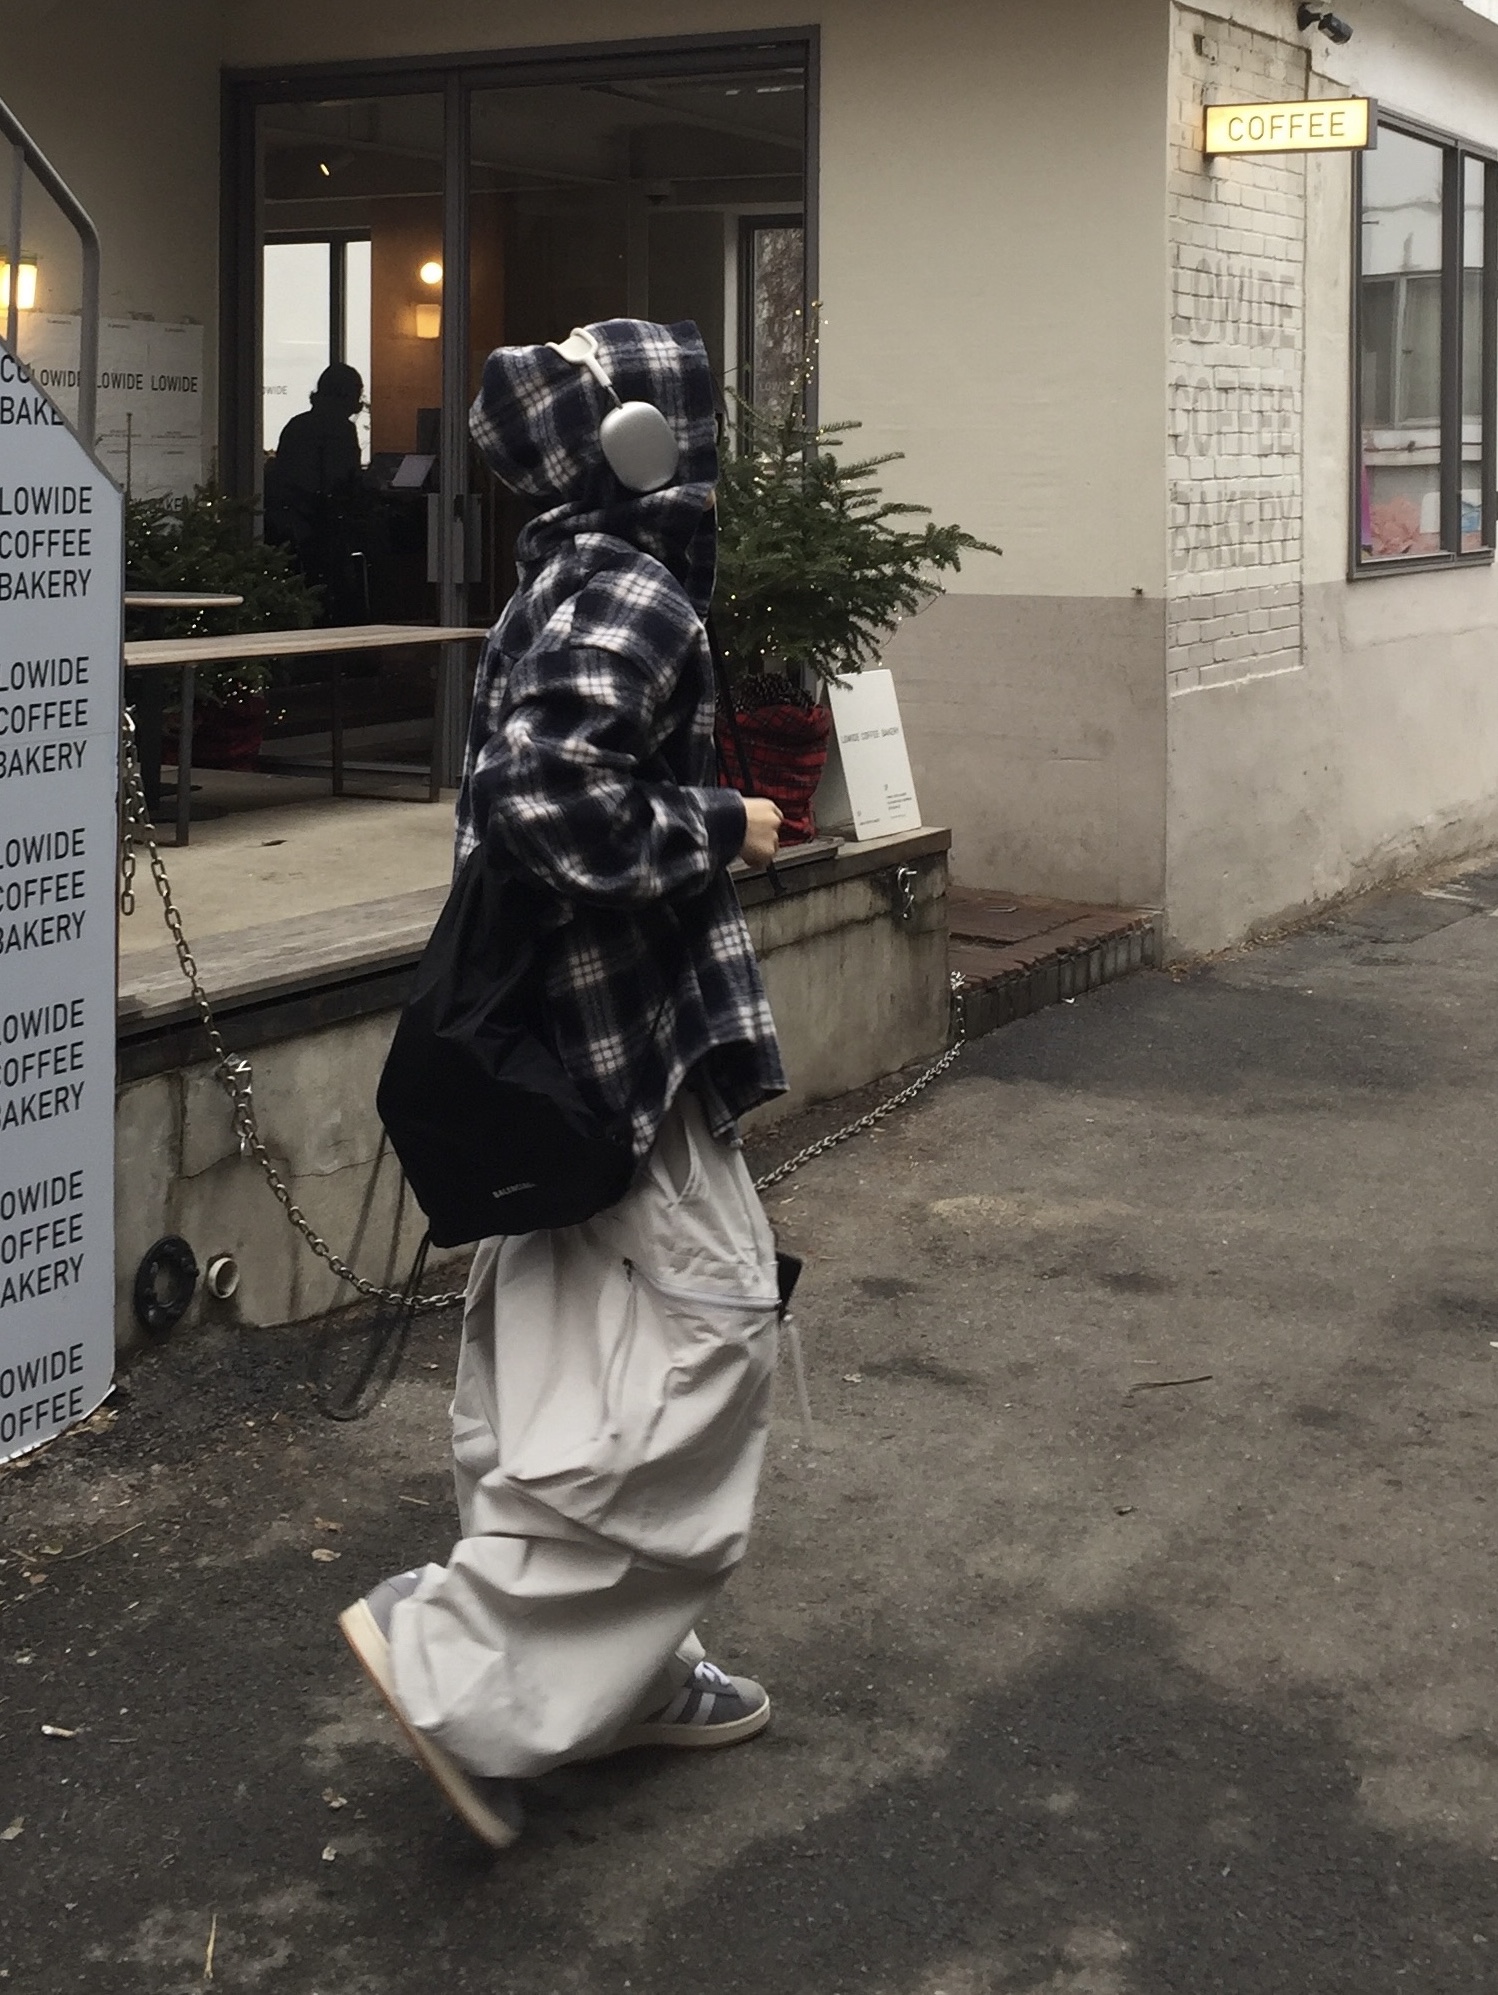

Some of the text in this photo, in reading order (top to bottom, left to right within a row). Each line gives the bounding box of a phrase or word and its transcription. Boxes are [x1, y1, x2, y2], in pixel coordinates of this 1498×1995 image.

[1228, 111, 1346, 141] COFFEE
[1171, 254, 1296, 350] LOWIDE
[151, 374, 198, 393] LOWIDE
[1171, 375, 1295, 456] COFFEE
[0, 486, 93, 516] LOWIDE
[0, 528, 92, 559] COFFEE
[1170, 489, 1294, 572] BAKERY
[0, 568, 92, 601] BAKERY
[0, 828, 86, 870] OWIDE
[0, 998, 85, 1045] OWIDE
[0, 1041, 84, 1087] OFFEE
[0, 1081, 85, 1131] AKERY
[0, 1170, 84, 1221] OWIDE
[0, 1213, 84, 1264] OFFEE
[0, 1253, 84, 1308] AKERY
[0, 1343, 84, 1400] OWIDE
[0, 1385, 84, 1443] OFFEE
